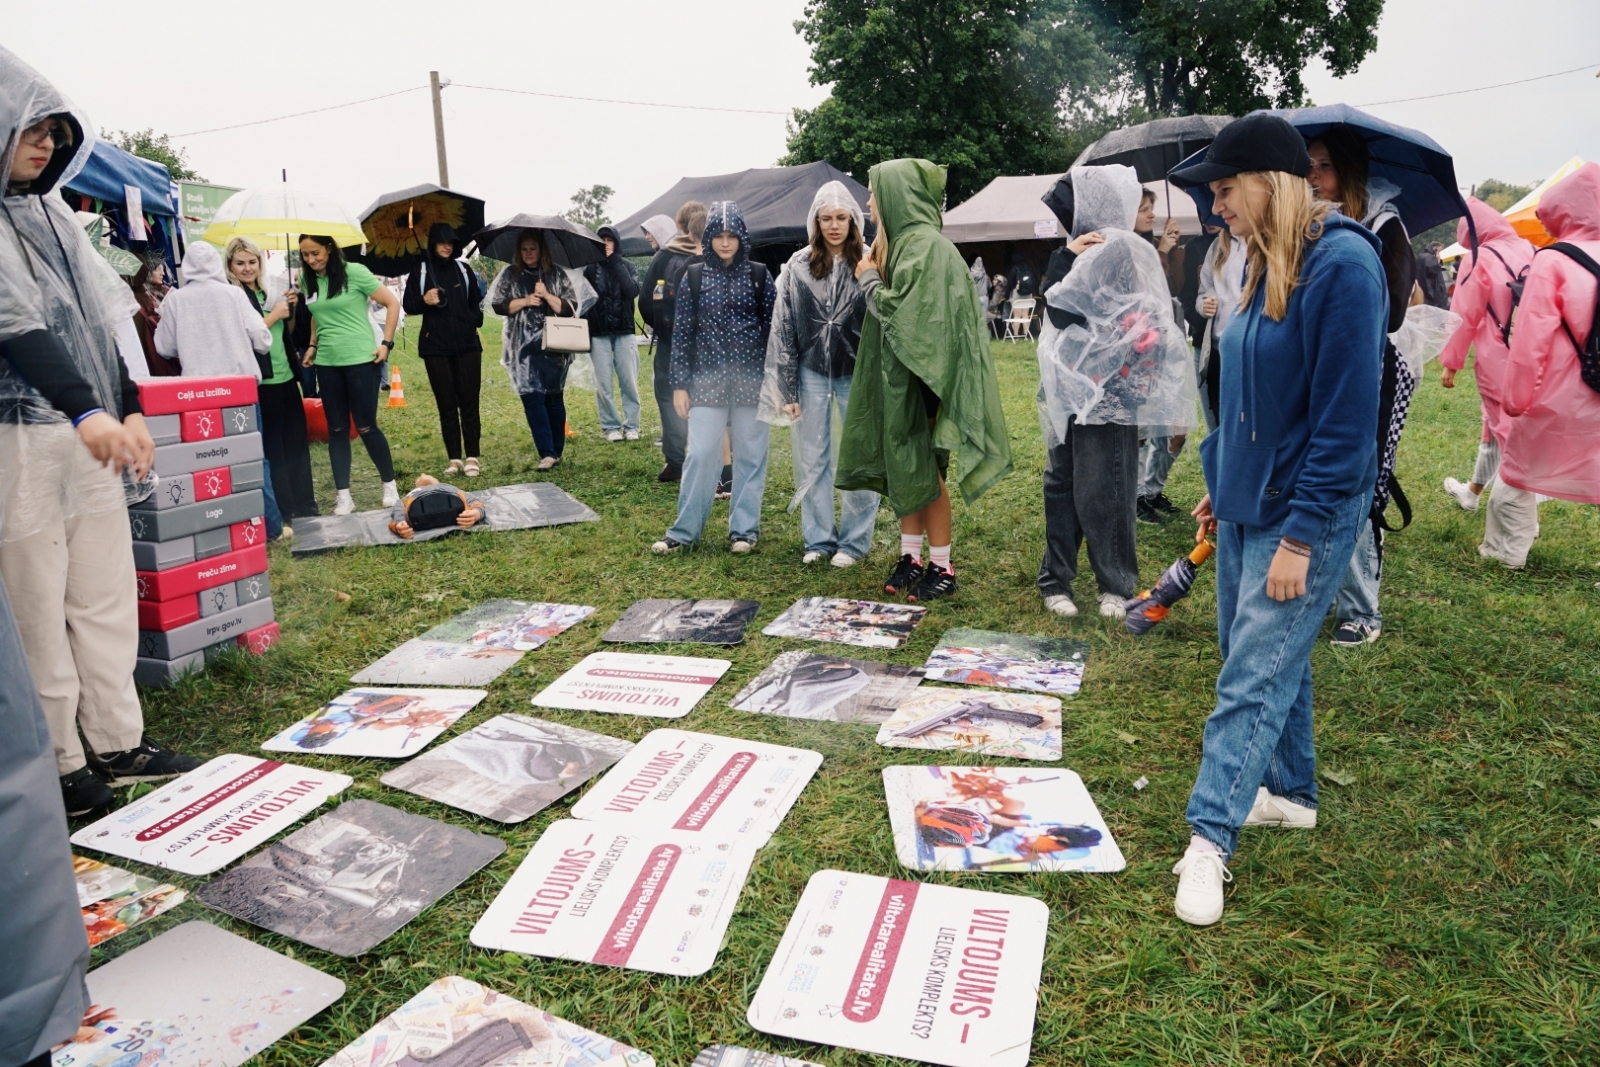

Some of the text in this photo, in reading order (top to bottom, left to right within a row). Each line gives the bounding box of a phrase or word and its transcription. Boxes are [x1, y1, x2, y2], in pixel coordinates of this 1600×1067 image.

[178, 390, 194, 401] Ceļš
[206, 388, 231, 397] izcilību
[196, 447, 228, 459] Inovācija
[206, 509, 223, 518] Logo
[198, 564, 236, 579] Preču zīme
[567, 681, 664, 694] LIELISKS KOMPLEKTS?
[592, 670, 700, 682] viltotarealitate.lv
[577, 689, 680, 707] VILTOJUMS
[604, 750, 684, 812] VILTOJUMS
[654, 742, 716, 802] LIELISKS KOMPLEKTS?
[686, 754, 752, 826] viltotarealitate.lv
[144, 768, 264, 838] viltotarealitate.lv
[207, 779, 322, 845] VILTOJUMS
[230, 789, 274, 815] LIELISKS
[165, 814, 234, 854] KOMPLEKTS?
[510, 848, 596, 934] VILTOJUMS
[568, 836, 630, 917] LIELISKS KOMPLEKTS?
[613, 847, 675, 948] viltotarealitate.lv
[851, 894, 906, 1016] viltotarealitate.lv
[949, 908, 1010, 1019] VILTOJUMS
[787, 962, 808, 992] GOALS
[910, 927, 957, 1040] LIELISKS KOMPLEKTS?
[56, 1054, 75, 1066] 20
[111, 1034, 145, 1052] 20
